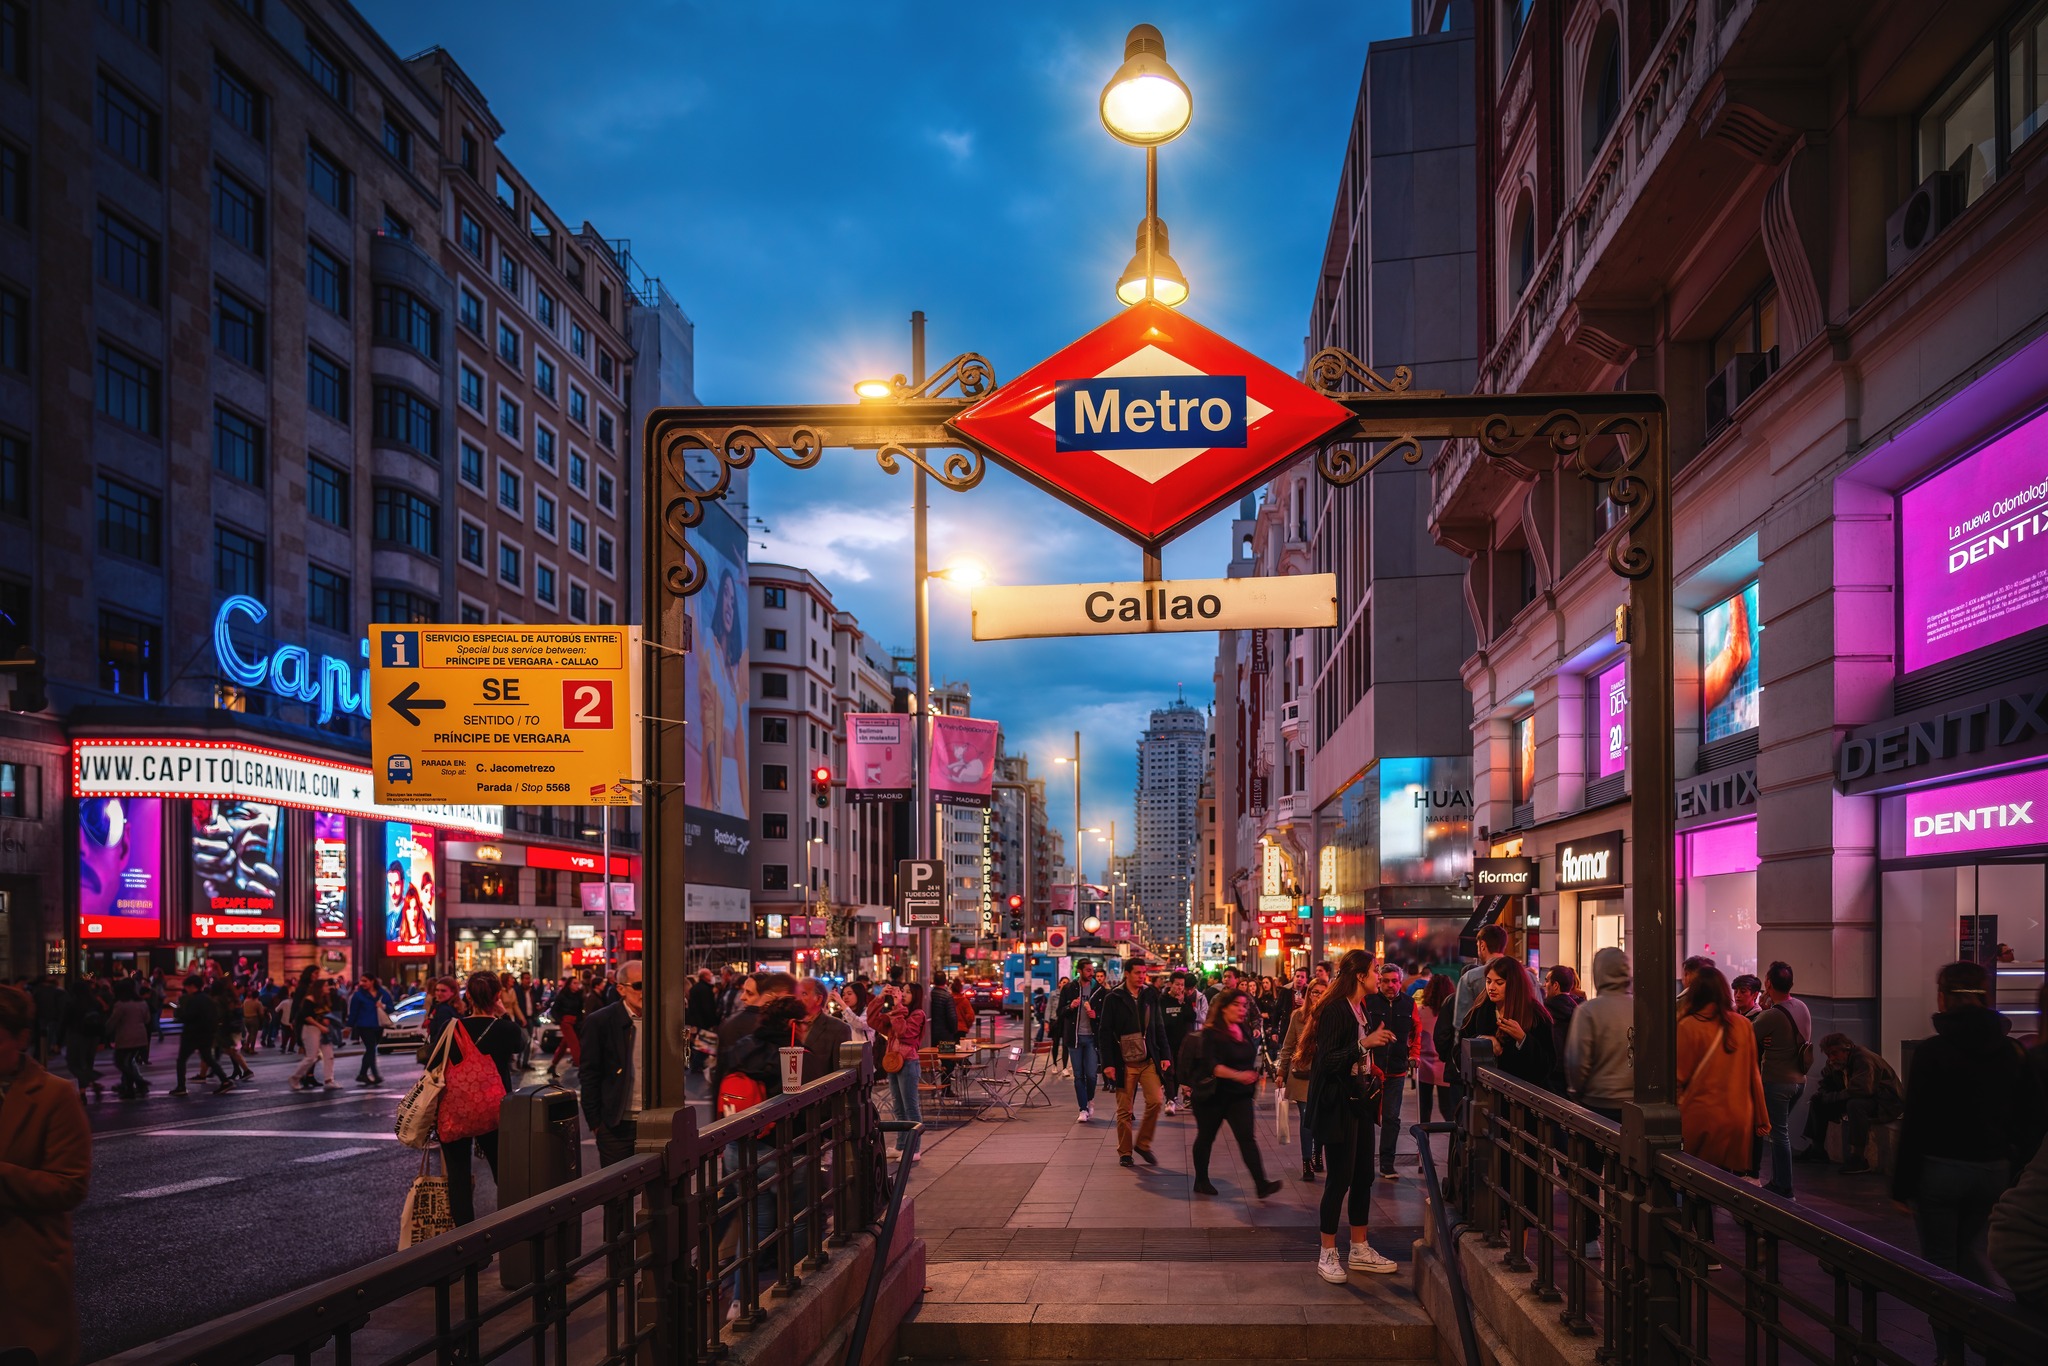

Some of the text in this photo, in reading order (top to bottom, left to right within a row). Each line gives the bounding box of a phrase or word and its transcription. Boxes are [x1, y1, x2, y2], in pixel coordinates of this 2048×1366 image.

[1073, 389, 1232, 435] Metro
[1949, 526, 1961, 540] La
[1962, 511, 1991, 532] nueva
[1949, 511, 2048, 574] DENTI
[1084, 589, 1222, 623] Callao
[425, 633, 618, 643] SERVICIO ESPECIAL DE AUTOBÚS ENTRE:
[456, 645, 587, 655] Special bus service between:
[445, 656, 491, 666] PRÍNCIPE
[493, 657, 506, 666] DE
[508, 658, 553, 666] VERGARA
[560, 658, 599, 666] CALLAO
[482, 678, 520, 701] SE
[573, 685, 601, 723] 2
[463, 715, 514, 725] SENTIDO
[524, 715, 540, 725] TO
[434, 731, 571, 744] PRÍNCIPE DE VERGARA
[1609, 724, 1622, 751] 20
[1840, 687, 2048, 783] DENTIX
[441, 768, 457, 776] Stop
[476, 763, 556, 773] C. Jacometrezo
[476, 783, 513, 792] Parada
[521, 783, 543, 794] Stop
[546, 783, 571, 792] 5568
[955, 797, 981, 805] MADRID
[1675, 770, 1760, 819] ENTIX
[1914, 801, 2034, 838] DENTIX
[571, 857, 594, 868] VIPS
[1562, 847, 1610, 884] flormar
[911, 863, 933, 891] P
[983, 847, 992, 930] EMPERADOR
[1478, 870, 1528, 884] flormar
[436, 1189, 445, 1218] SPAIN
